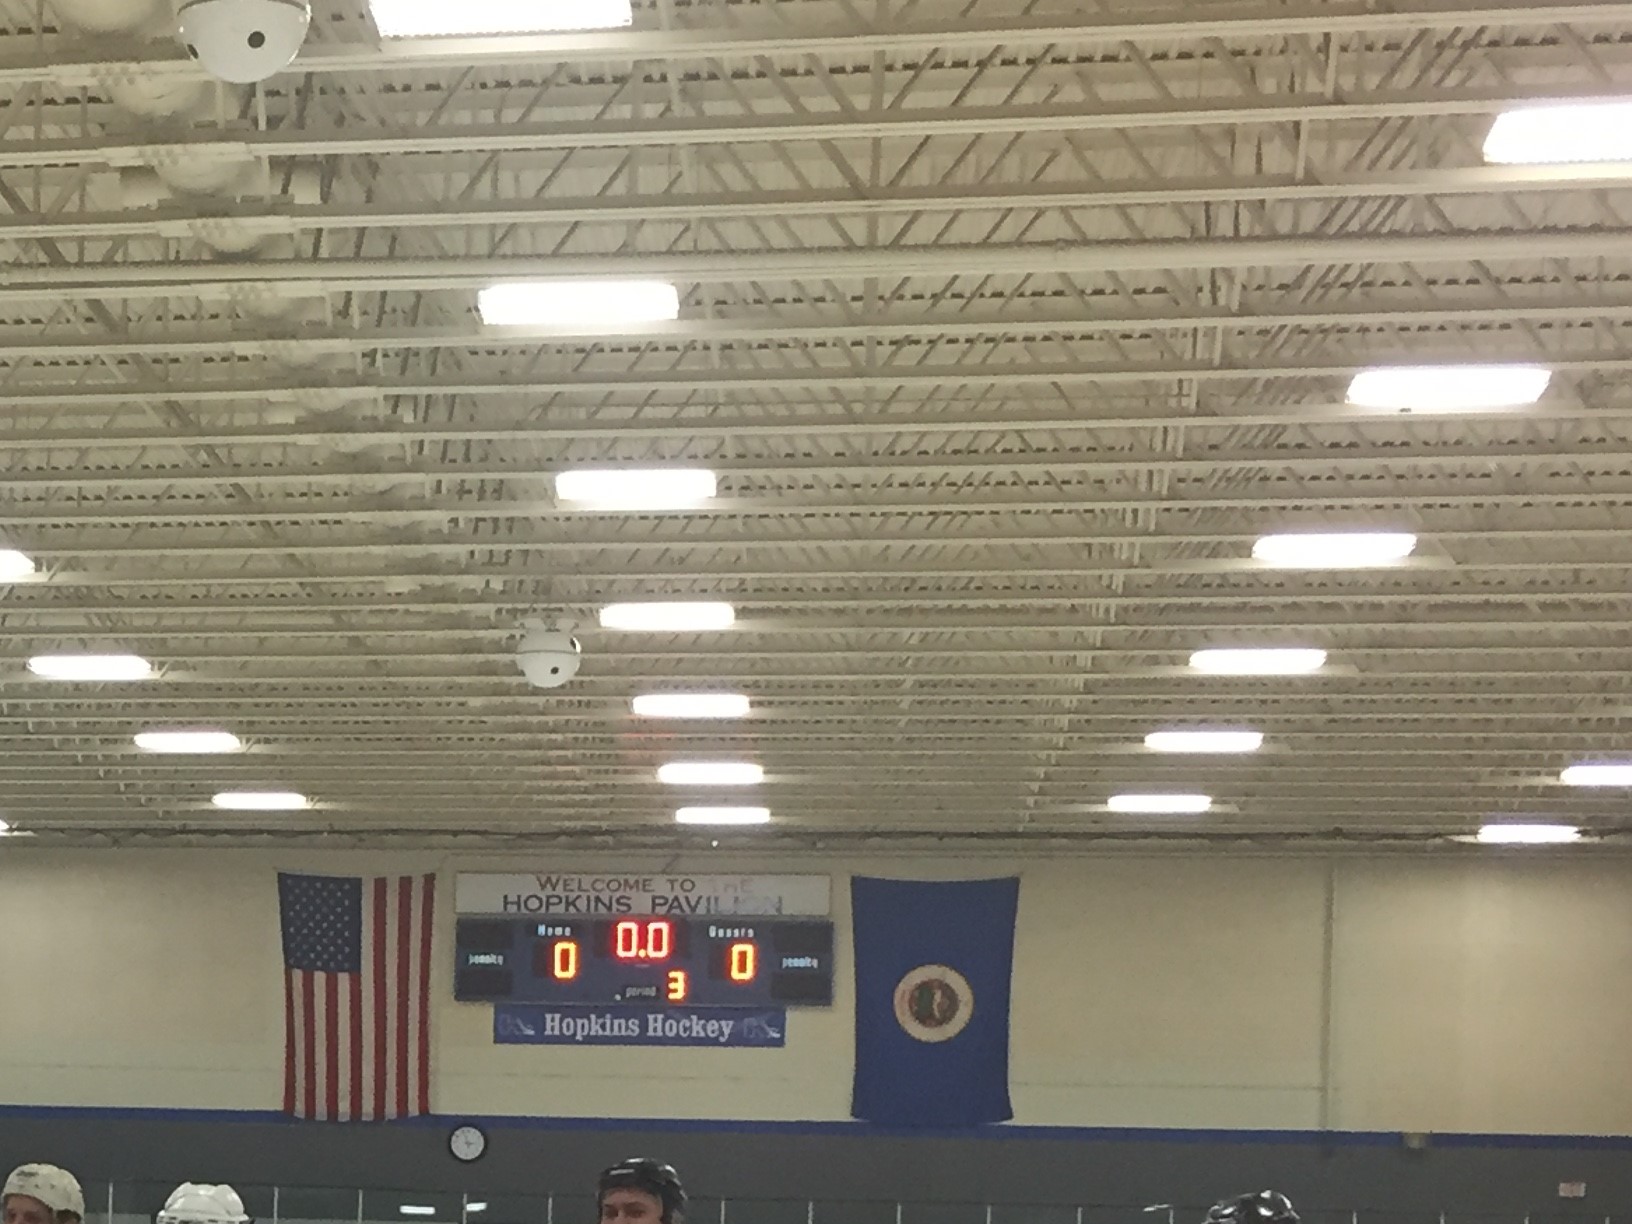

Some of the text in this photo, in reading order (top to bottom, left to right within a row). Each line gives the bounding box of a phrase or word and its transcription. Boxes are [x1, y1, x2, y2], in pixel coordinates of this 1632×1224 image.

[535, 876, 653, 892] WELCOME
[665, 878, 695, 892] TO
[502, 894, 633, 913] HOPKINS
[553, 941, 577, 980] 0
[729, 943, 755, 981] 0
[666, 969, 686, 1001] 3
[543, 1012, 735, 1043] Hopkins Hockey
